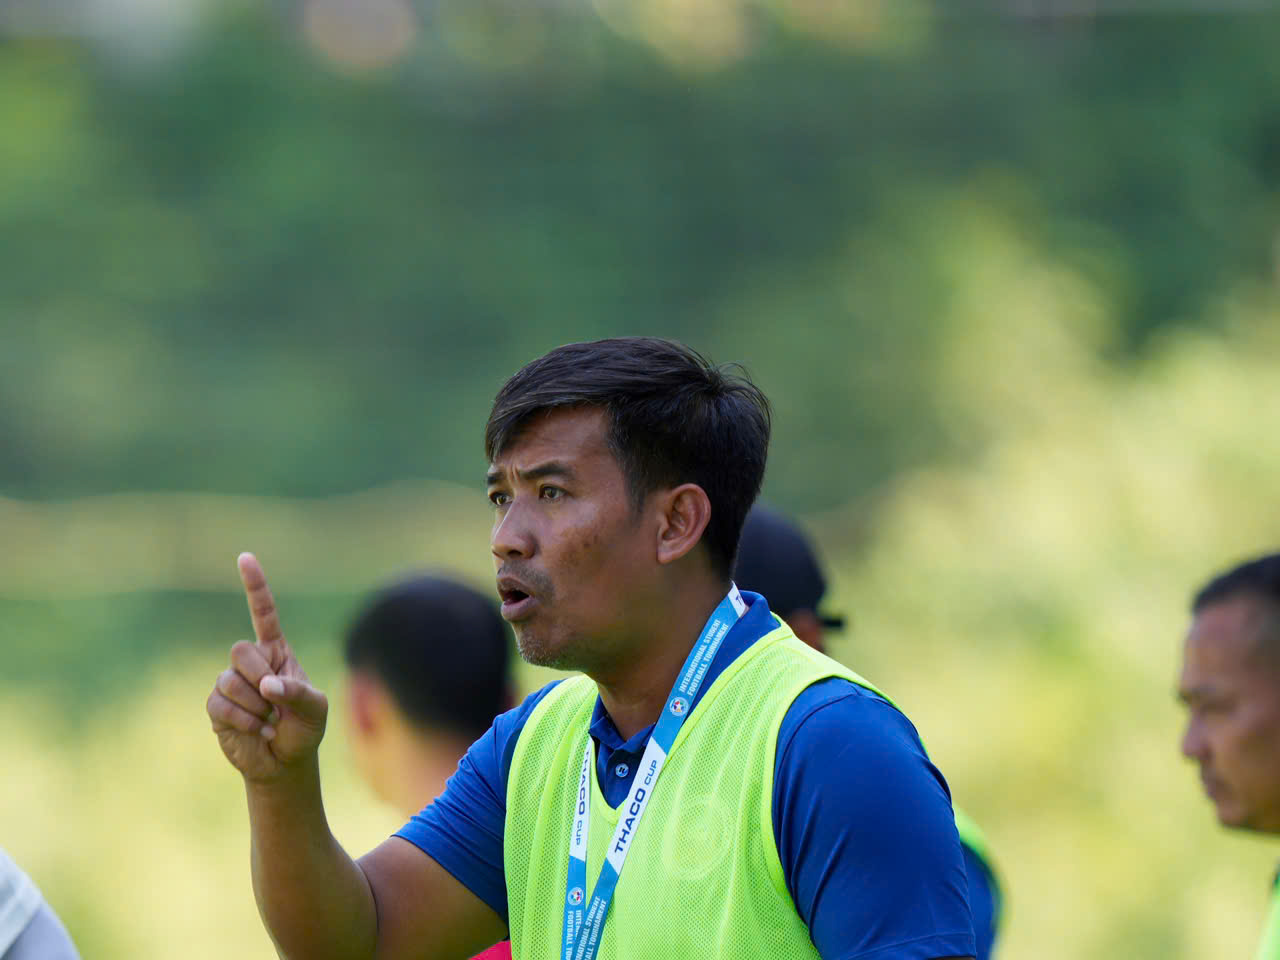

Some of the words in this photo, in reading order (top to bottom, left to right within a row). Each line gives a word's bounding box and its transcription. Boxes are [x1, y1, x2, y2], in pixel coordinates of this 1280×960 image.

[687, 663, 707, 696] FOOTBALL
[614, 787, 646, 853] THACO
[644, 760, 657, 785] CUP
[585, 896, 601, 927] STUDENT
[589, 899, 607, 945] TOURNAMENT
